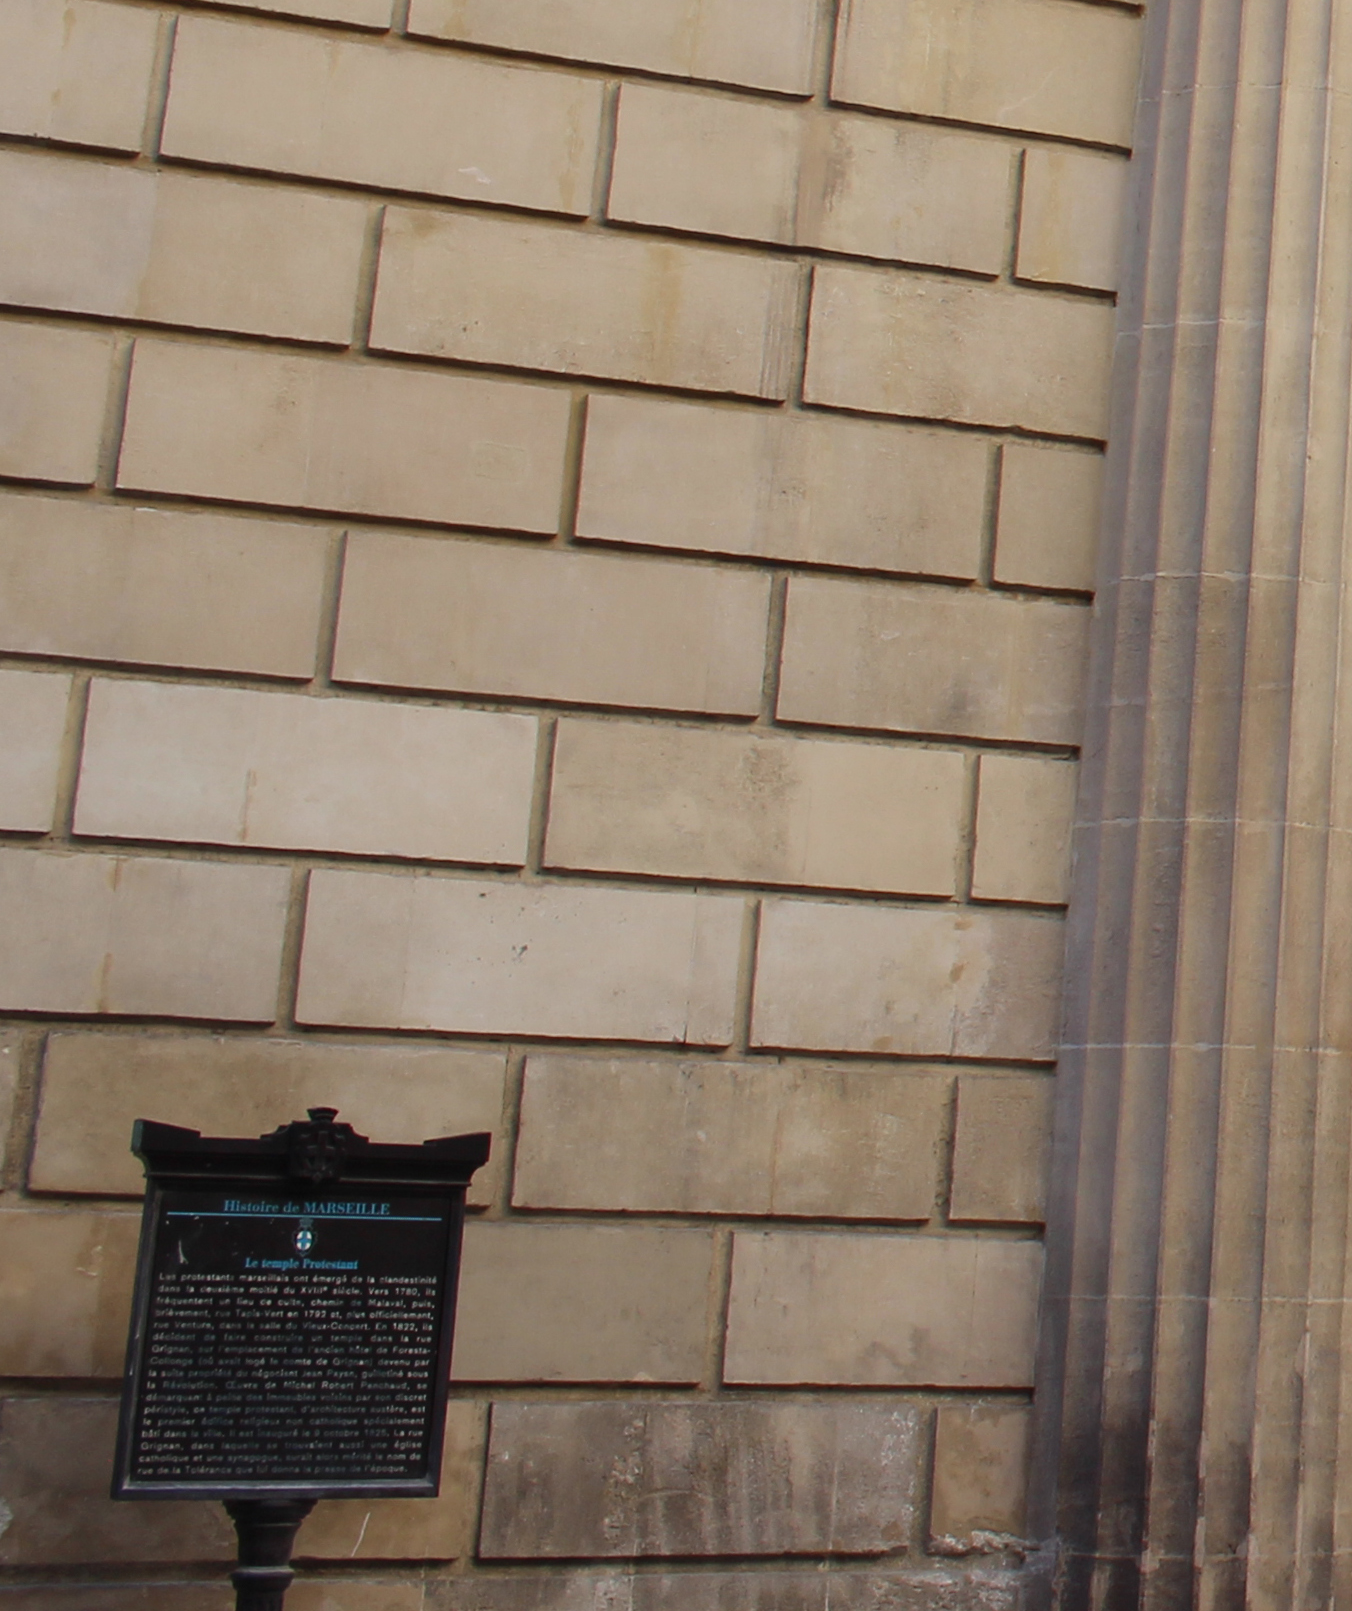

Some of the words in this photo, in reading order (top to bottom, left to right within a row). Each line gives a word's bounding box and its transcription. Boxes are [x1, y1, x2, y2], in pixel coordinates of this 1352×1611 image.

[224, 1200, 279, 1212] Histoire
[283, 1201, 299, 1213] de
[303, 1201, 390, 1215] MARSEILLE
[245, 1257, 258, 1268] Le
[262, 1258, 299, 1271] temple
[303, 1258, 359, 1269] Protestant
